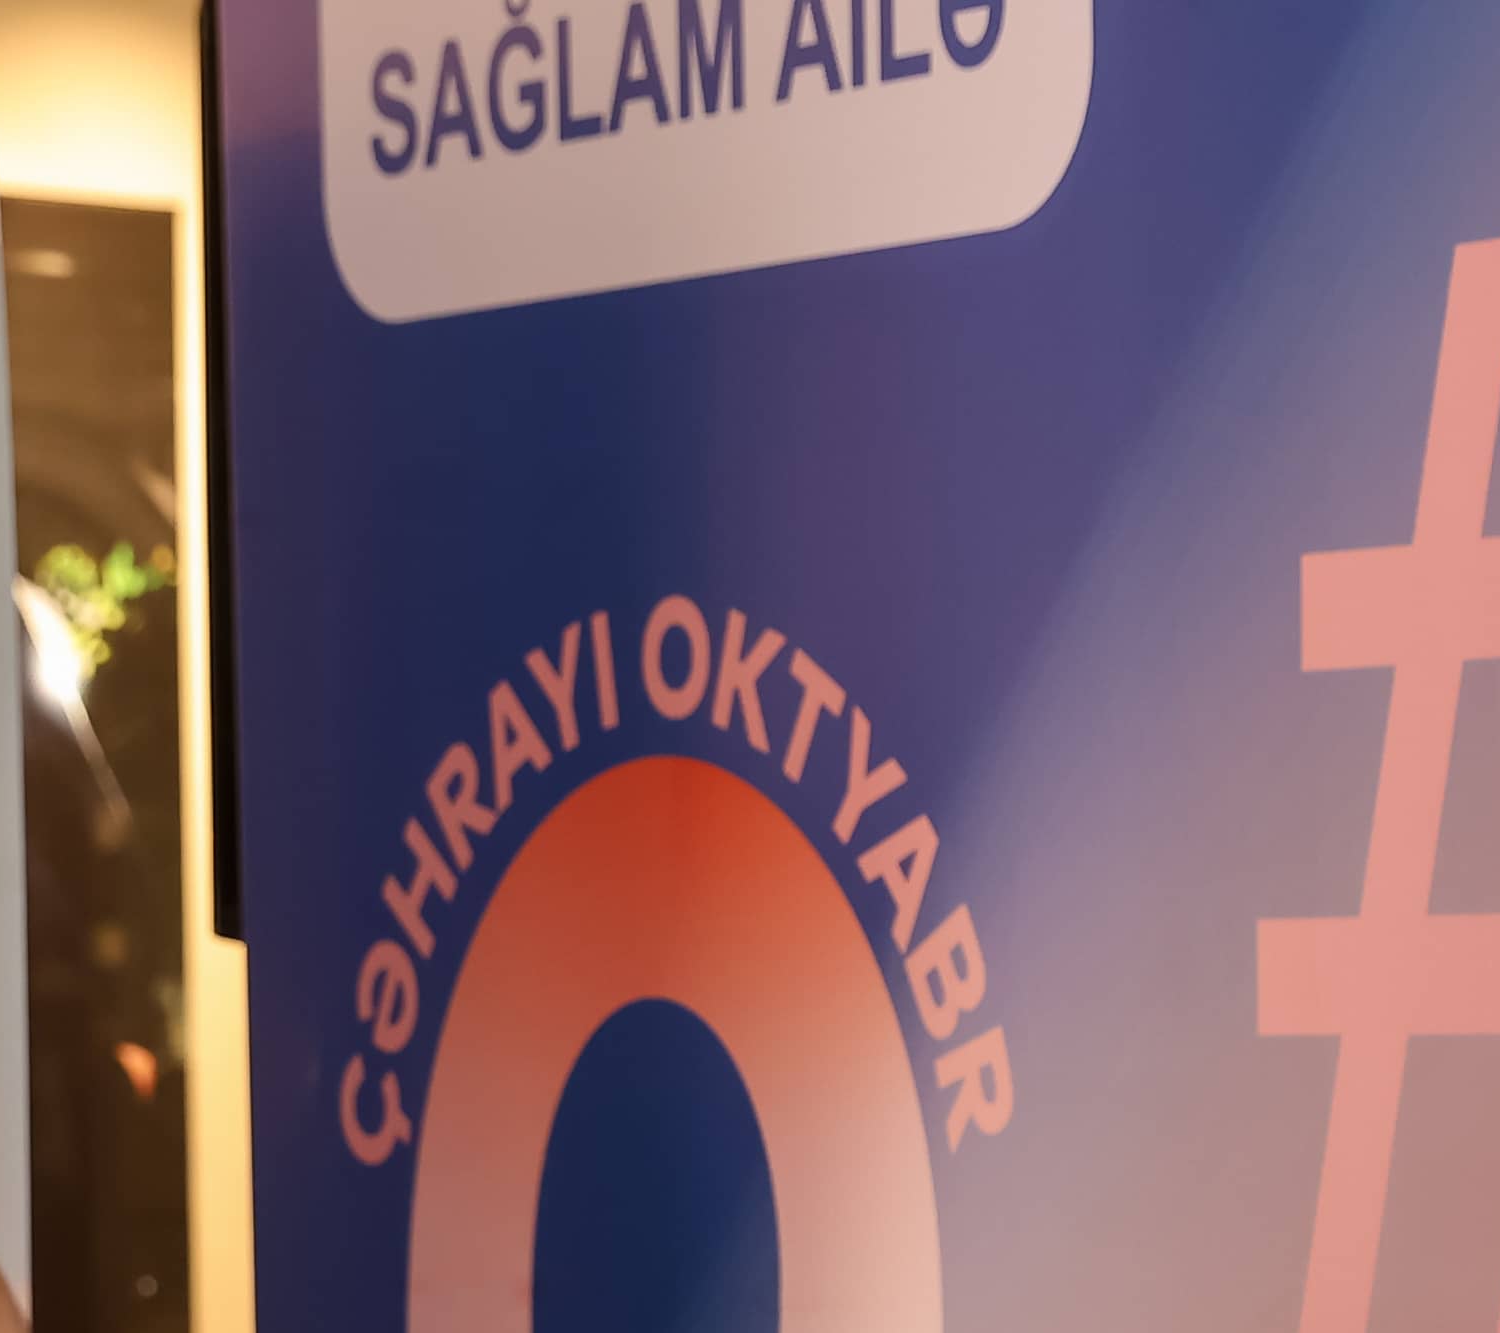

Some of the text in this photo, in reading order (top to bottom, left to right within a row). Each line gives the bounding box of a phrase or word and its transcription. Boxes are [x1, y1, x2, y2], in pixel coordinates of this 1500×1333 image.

[368, 0, 747, 177] SAĞLAM
[338, 593, 1014, 1167] ÇƏHRAYI OKTYABR
